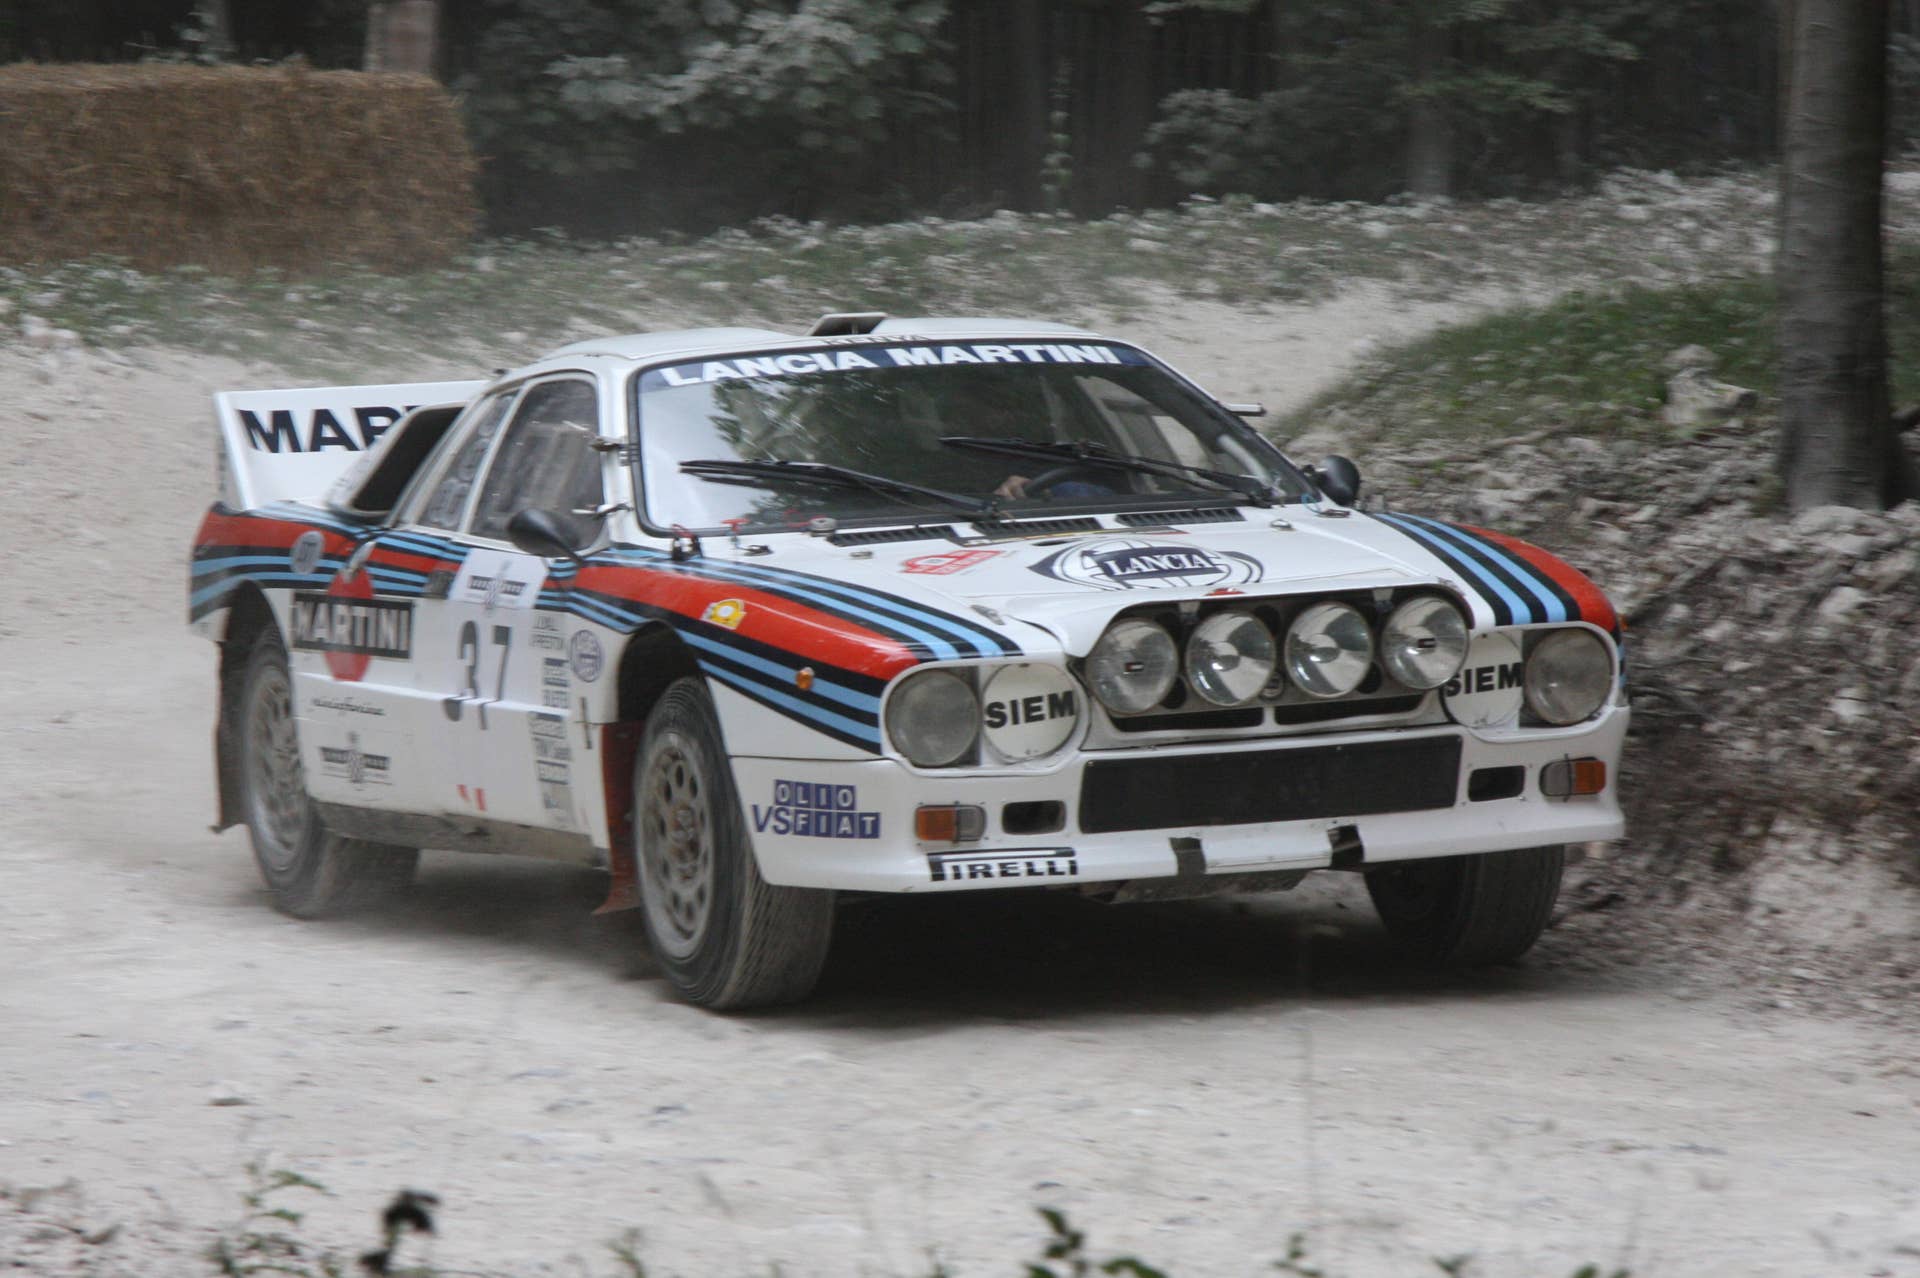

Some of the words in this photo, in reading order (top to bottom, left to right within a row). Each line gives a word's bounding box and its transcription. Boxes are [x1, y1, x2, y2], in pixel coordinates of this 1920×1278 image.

[659, 350, 879, 387] LANCIA
[886, 343, 1124, 367] MARTINI
[236, 405, 421, 453] MAR
[1104, 553, 1213, 576] LANCIA
[292, 601, 409, 650] MARTINI
[443, 620, 513, 731] 37
[1445, 662, 1524, 697] SIEM
[984, 690, 1076, 729] SIEM
[775, 783, 853, 808] OLIO
[927, 848, 1079, 881] PIRELLI
